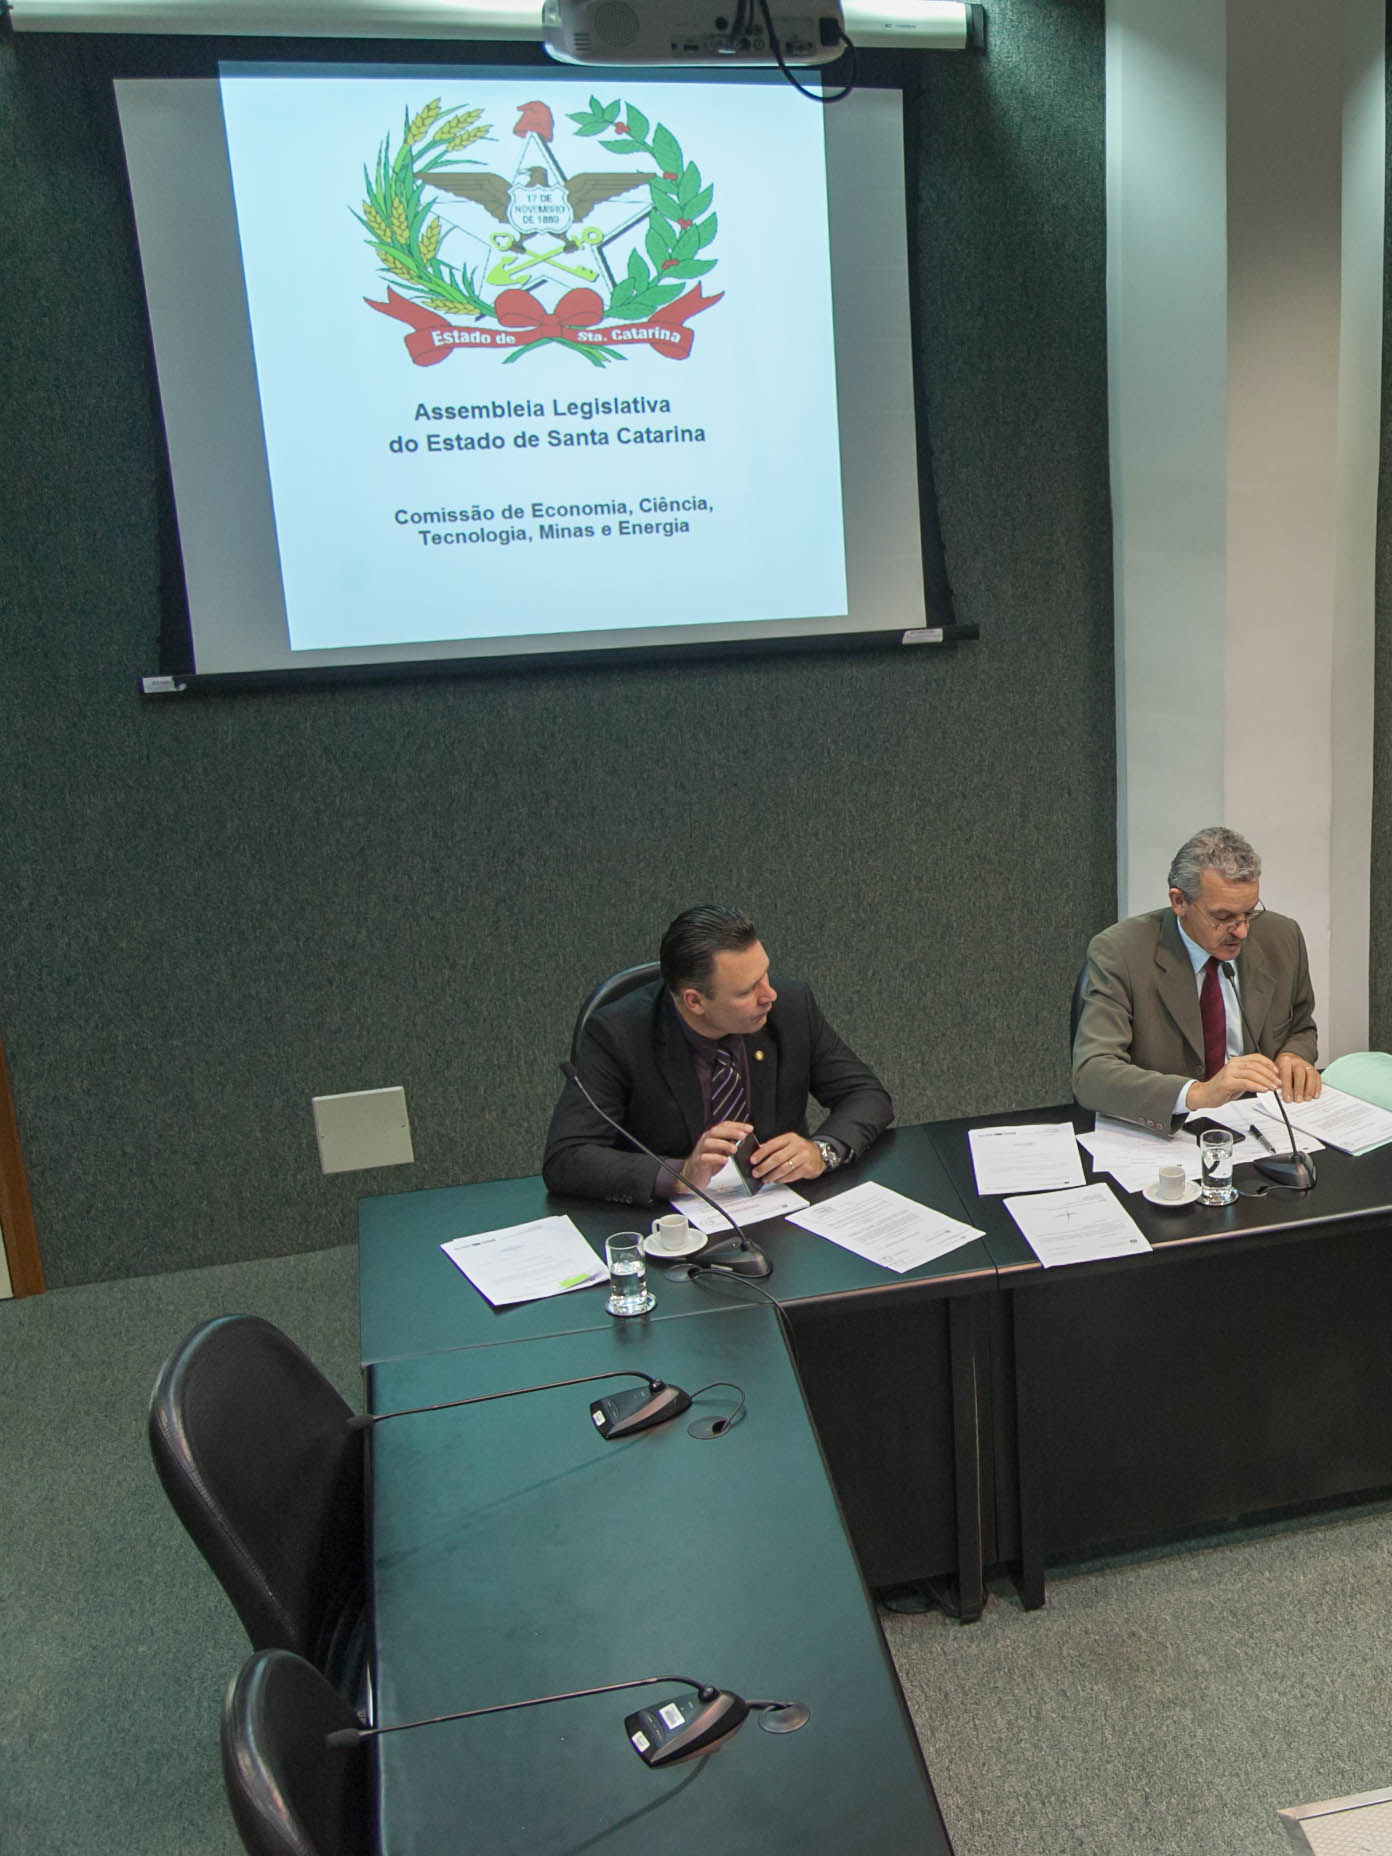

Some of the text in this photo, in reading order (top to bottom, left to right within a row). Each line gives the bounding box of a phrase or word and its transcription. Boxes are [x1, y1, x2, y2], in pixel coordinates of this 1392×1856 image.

[522, 215, 535, 224] DE
[431, 325, 681, 346] Estado de Sta. Catarina
[414, 395, 672, 421] Assembleia Legislativa
[388, 424, 707, 454] do Estado de Santa Catarina
[394, 495, 715, 526] Comissão de Economia, Ciência,
[417, 517, 691, 547] Tecnologia, Minas e Energia
